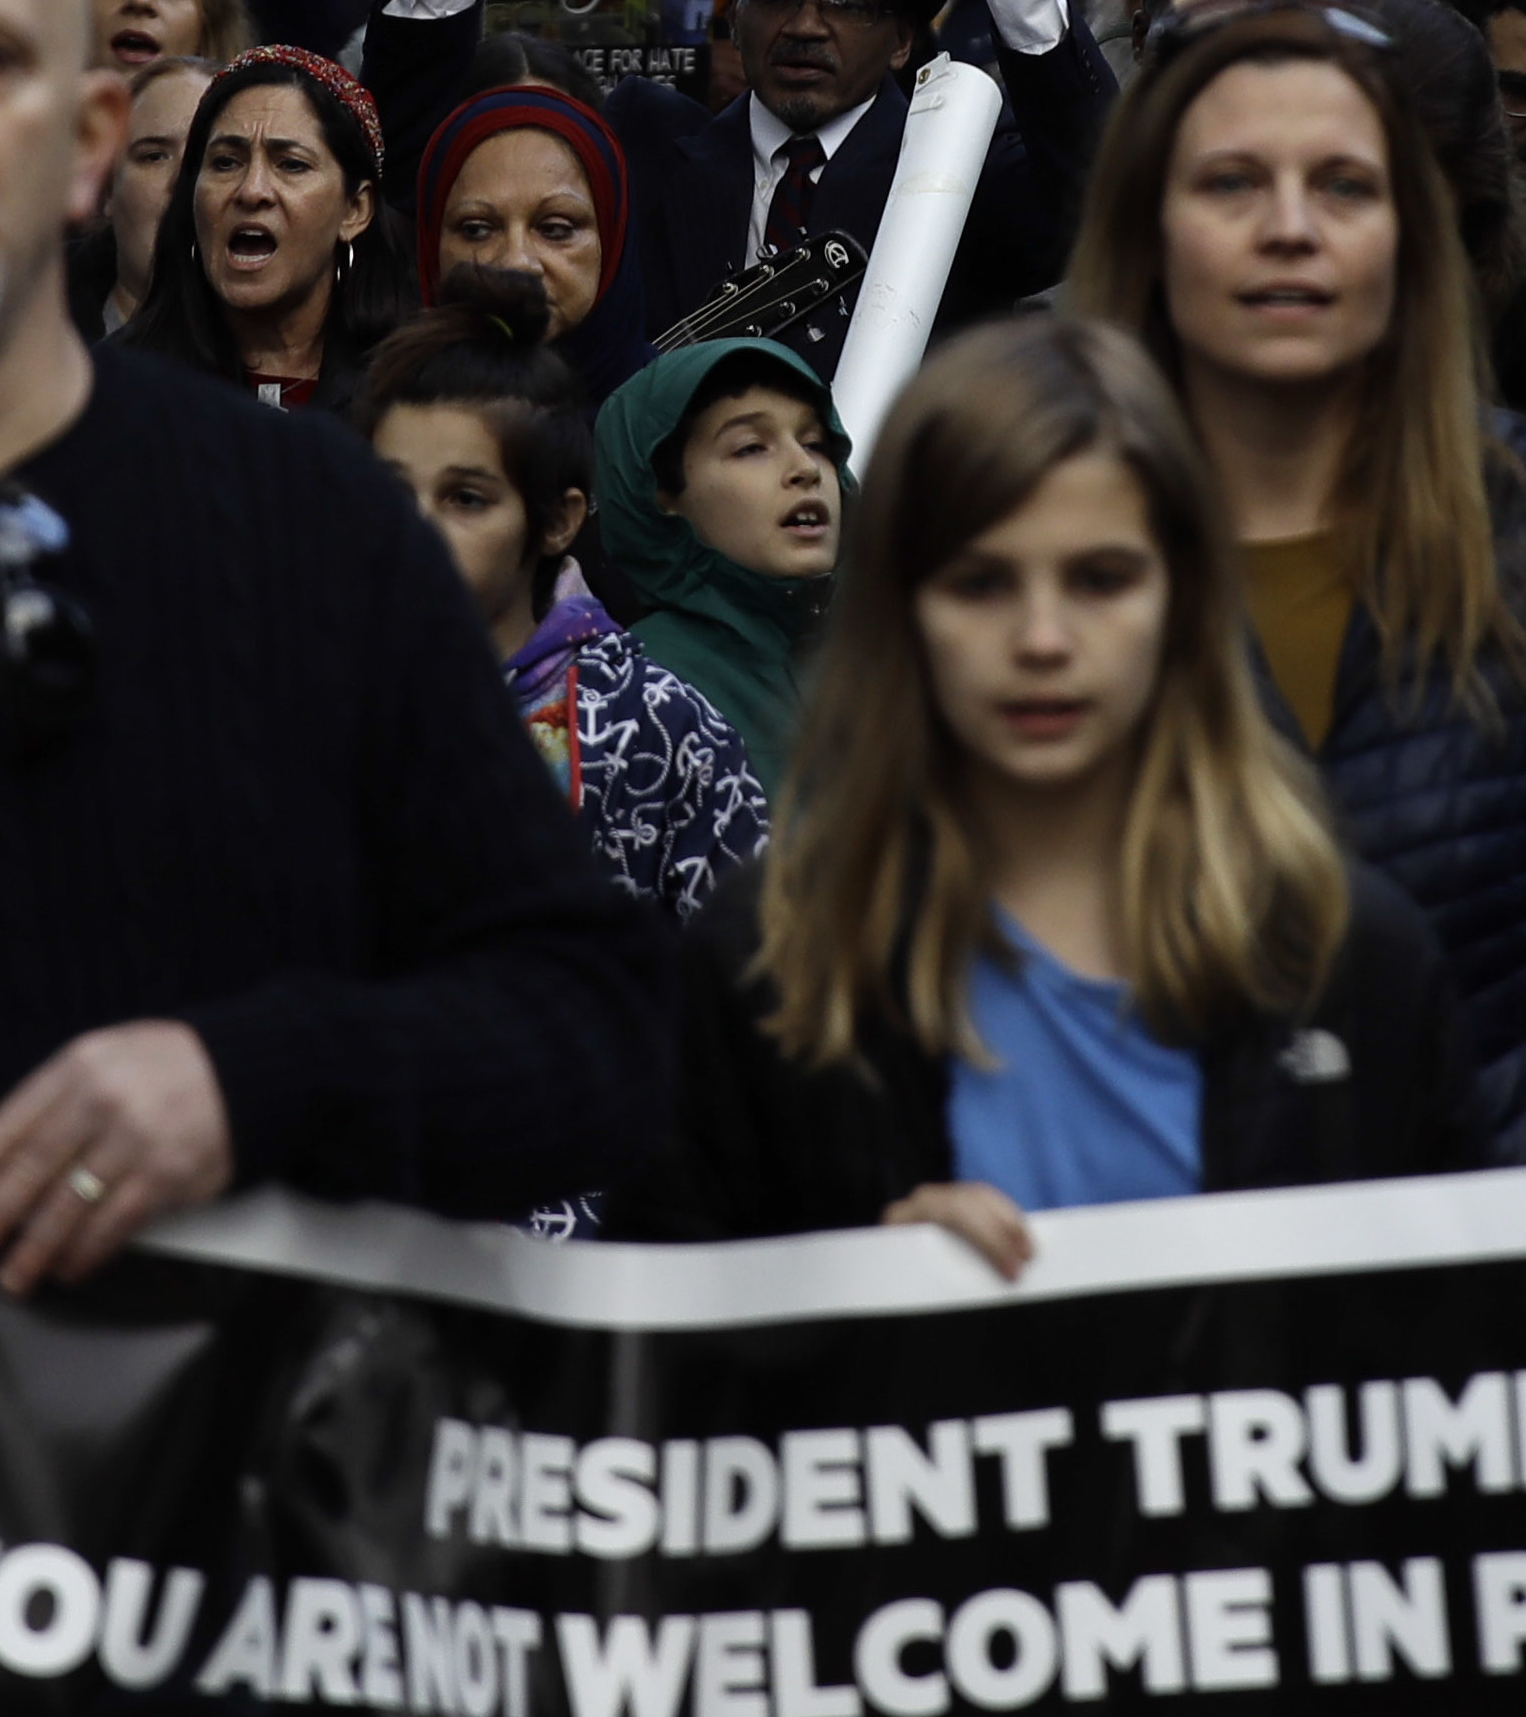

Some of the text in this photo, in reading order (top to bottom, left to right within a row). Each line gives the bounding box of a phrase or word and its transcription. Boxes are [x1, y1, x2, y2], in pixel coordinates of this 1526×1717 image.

[611, 48, 643, 72] FOR
[648, 47, 696, 72] HATE
[424, 1408, 1072, 1559] PRESIDENT
[195, 1574, 403, 1706] ARE
[400, 1590, 543, 1717] NOT
[557, 1567, 1277, 1717] WELCOME
[1302, 1556, 1451, 1682] IN
